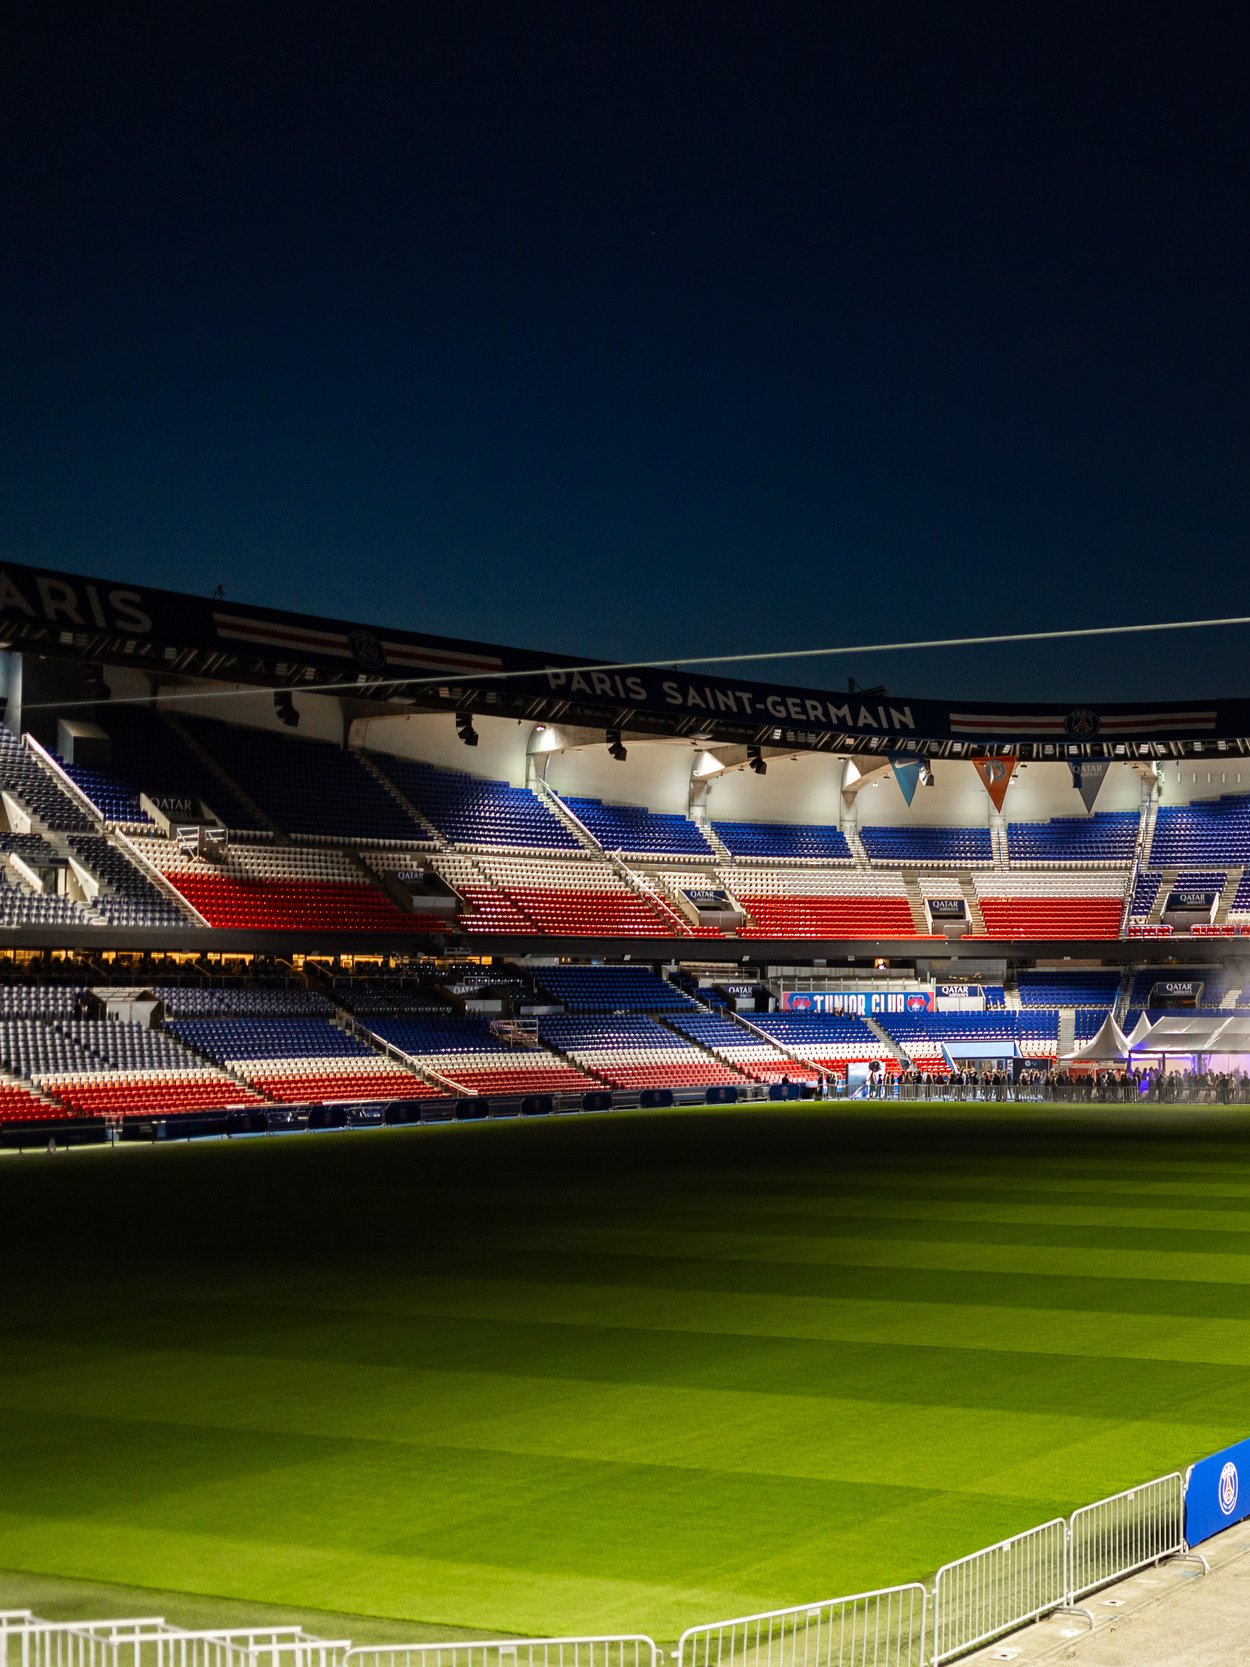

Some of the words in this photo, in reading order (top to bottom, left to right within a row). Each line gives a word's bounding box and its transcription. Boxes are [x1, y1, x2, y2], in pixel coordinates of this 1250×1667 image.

[546, 664, 648, 701] PARIS
[661, 680, 916, 729] SAINT-GERMAIN
[398, 871, 424, 881] QATAR
[690, 890, 714, 899] QATAR
[1180, 894, 1205, 902] QATAR
[932, 900, 959, 909] QATAR
[728, 986, 753, 994] QATAR
[941, 986, 969, 995] QATAR
[1166, 983, 1192, 992] QATAR
